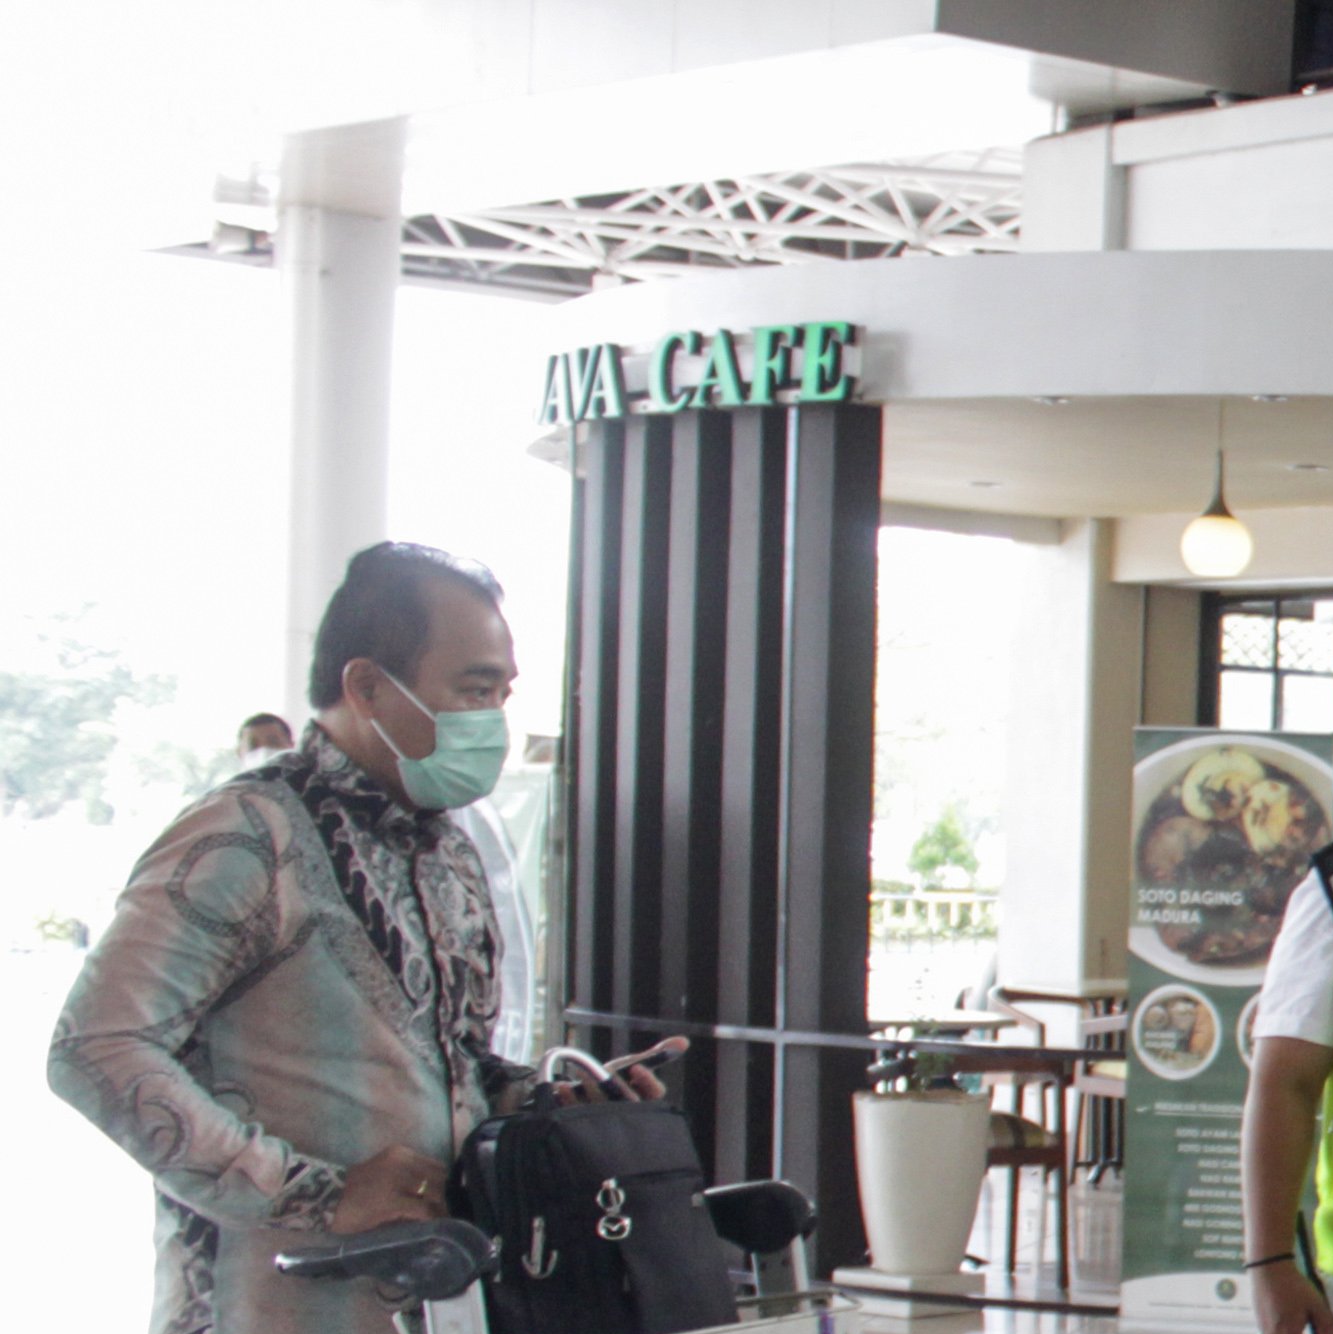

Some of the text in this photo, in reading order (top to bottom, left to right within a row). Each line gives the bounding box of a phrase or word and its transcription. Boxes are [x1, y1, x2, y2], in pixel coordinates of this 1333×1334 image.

[649, 320, 859, 415] CAFE
[1137, 888, 1244, 906] SOTO DAGING
[1137, 909, 1201, 924] MADURA
